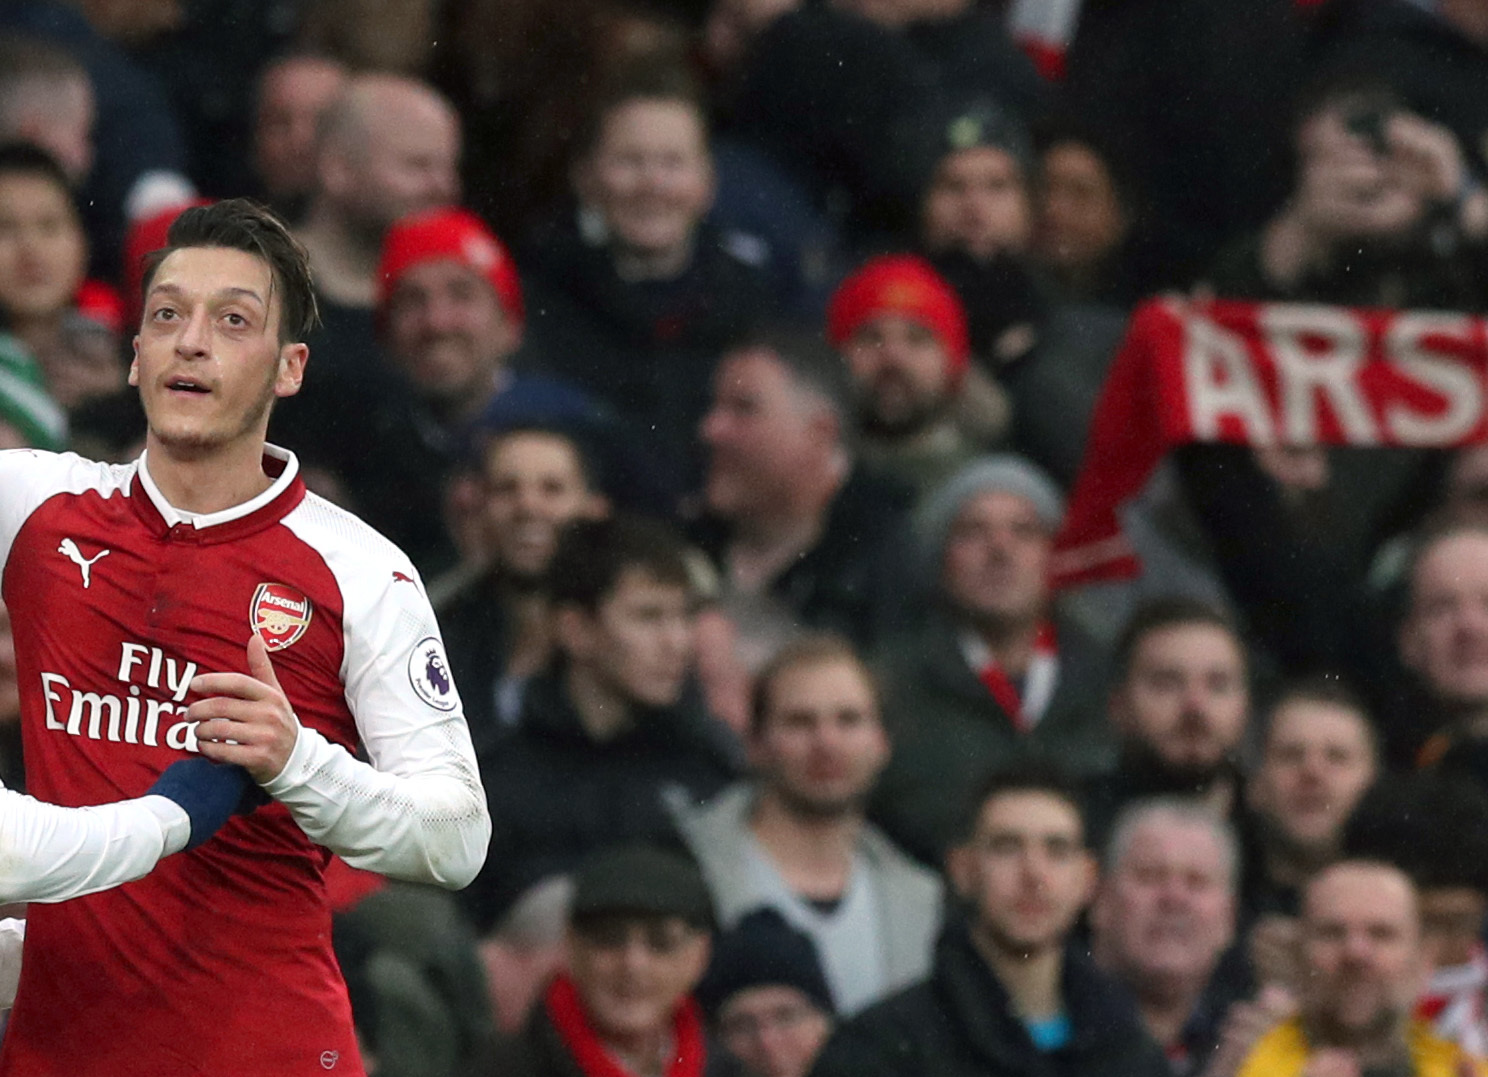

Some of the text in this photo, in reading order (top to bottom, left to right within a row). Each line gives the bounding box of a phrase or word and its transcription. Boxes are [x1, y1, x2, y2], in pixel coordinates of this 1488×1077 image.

[260, 591, 305, 613] Arsenal
[118, 642, 198, 703] Fly
[41, 671, 200, 753] Emira
